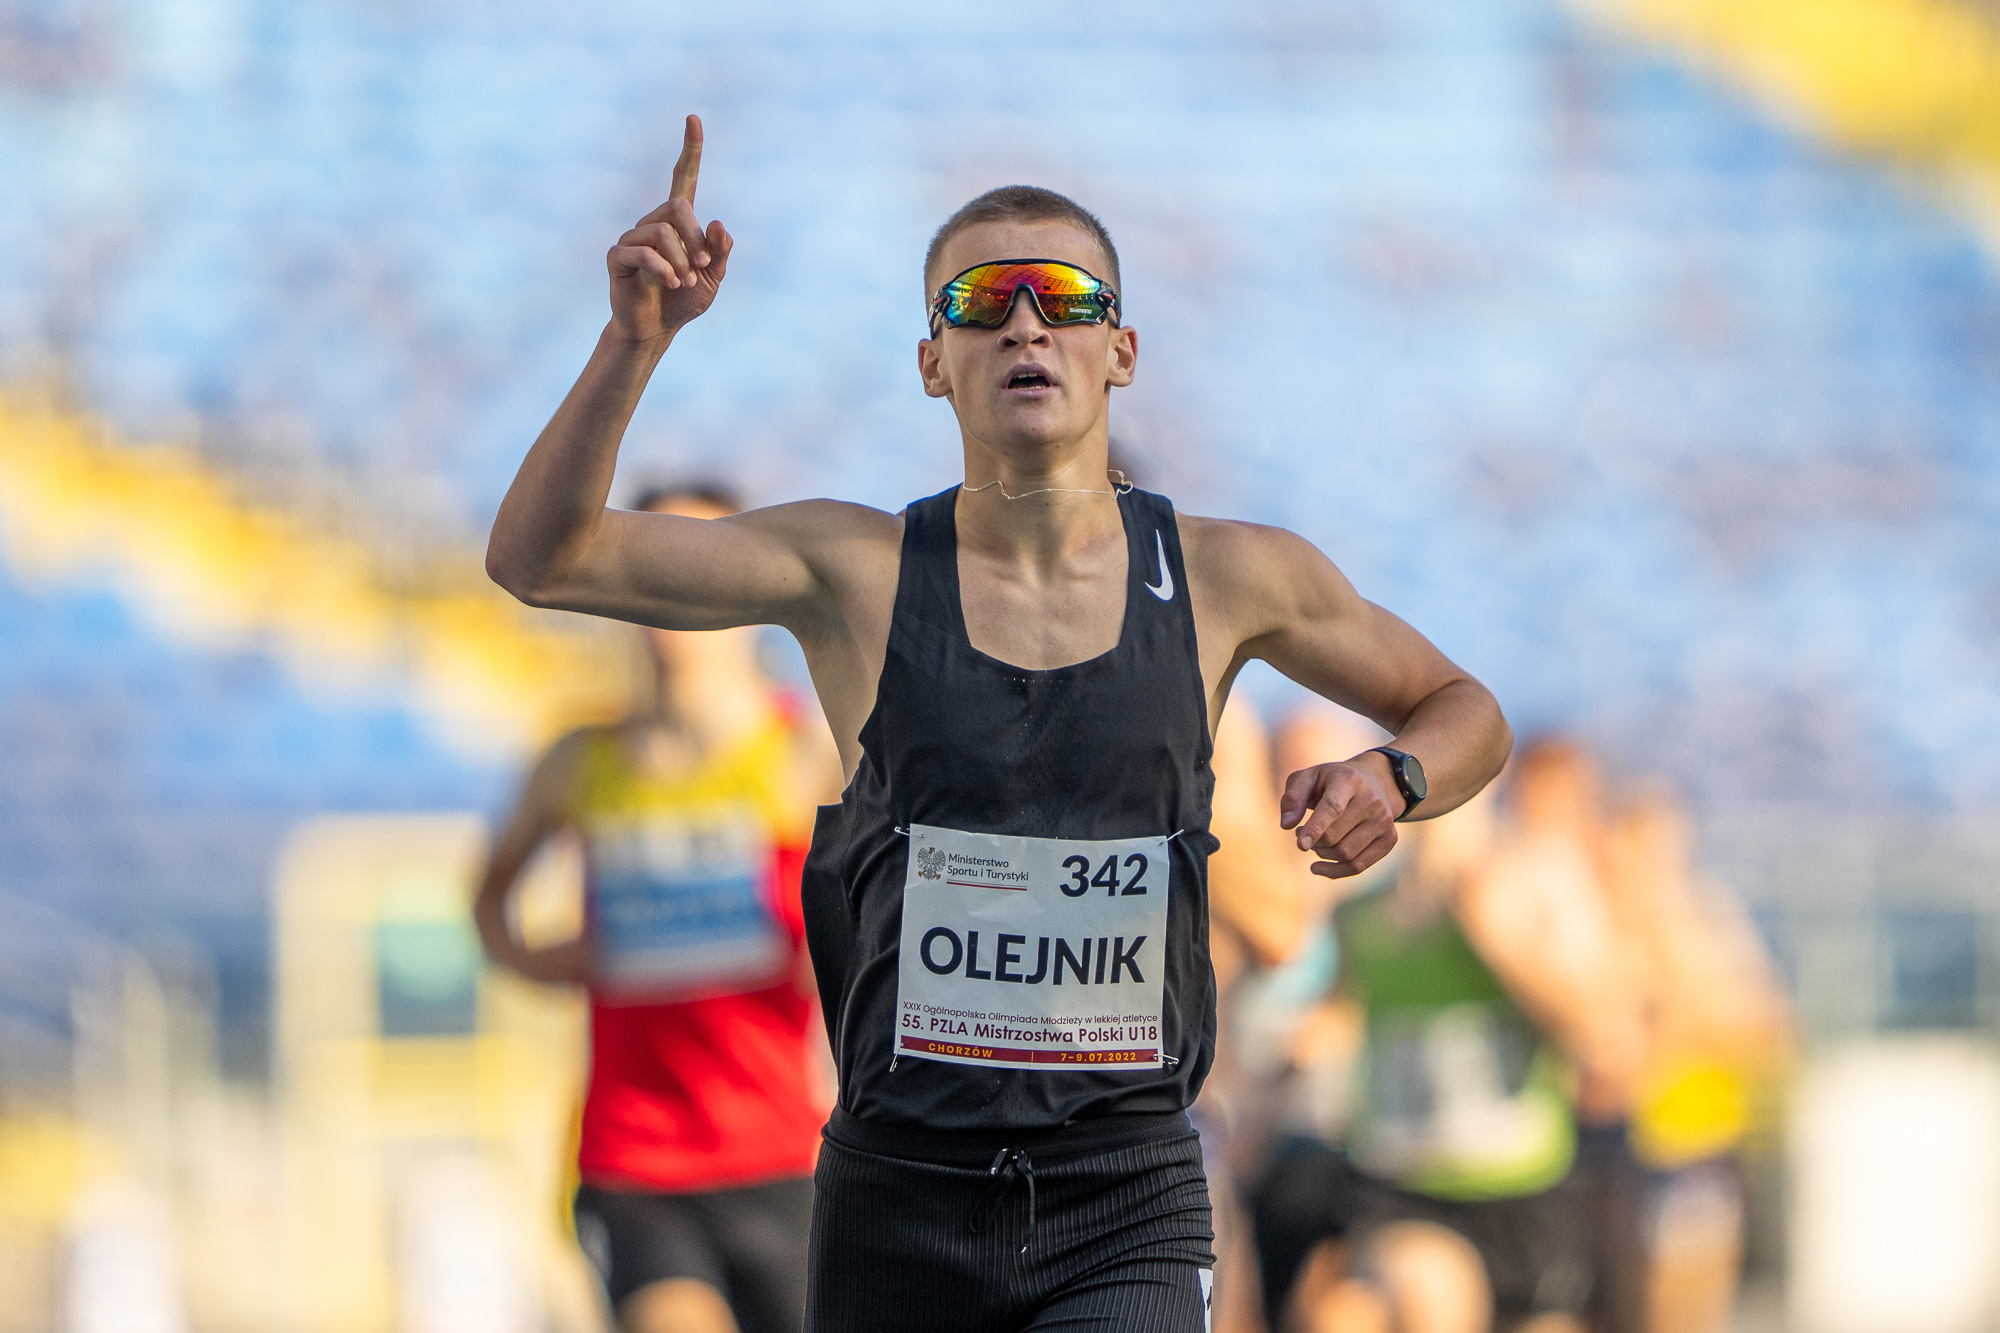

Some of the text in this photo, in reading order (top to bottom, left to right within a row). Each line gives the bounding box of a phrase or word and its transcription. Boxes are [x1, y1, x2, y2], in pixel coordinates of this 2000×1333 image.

[948, 853, 1009, 868] Ministerstwo
[947, 865, 1029, 882] Sportu i Turystyki
[1059, 852, 1149, 898] 342
[920, 926, 1148, 986] OLEJNIK
[903, 1001, 921, 1012] XXIX
[923, 1005, 986, 1020] Ogólnopolska
[988, 1012, 1038, 1024] Olimpiada
[1040, 1015, 1083, 1026] Młodzieży
[1094, 1015, 1121, 1025] lekkiej
[1122, 1014, 1158, 1024] atletyce
[901, 1013, 1158, 1042] 55. PZLA Mistrzostwa Polski U18
[928, 1043, 993, 1058] CHORZÓW
[1061, 1052, 1137, 1062] 7-9.07.2022
